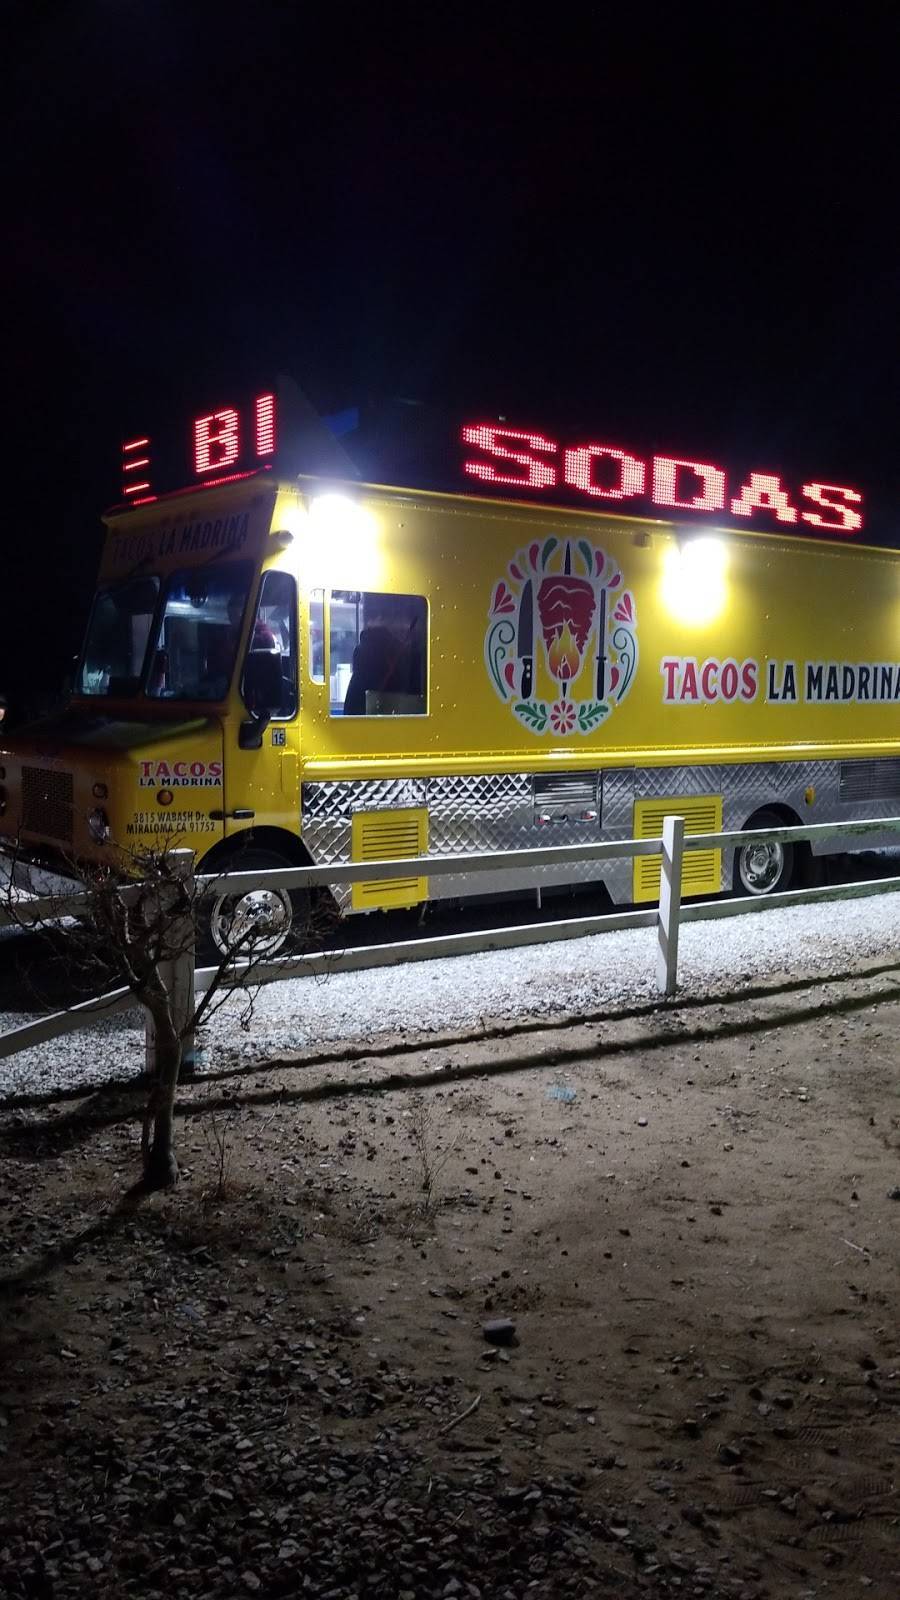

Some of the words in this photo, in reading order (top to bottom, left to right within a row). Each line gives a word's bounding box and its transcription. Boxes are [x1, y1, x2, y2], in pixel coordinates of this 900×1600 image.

[461, 424, 864, 532] SODAS
[663, 658, 757, 700] TACOS
[768, 663, 797, 700] LA
[274, 733, 284, 745] 15
[140, 761, 223, 777] TACOS
[140, 777, 156, 786] LA
[161, 777, 222, 786] MADRINA
[134, 812, 155, 823] 3815
[158, 811, 193, 822] WABASH
[176, 823, 187, 833] CA
[189, 822, 215, 832] 91752
